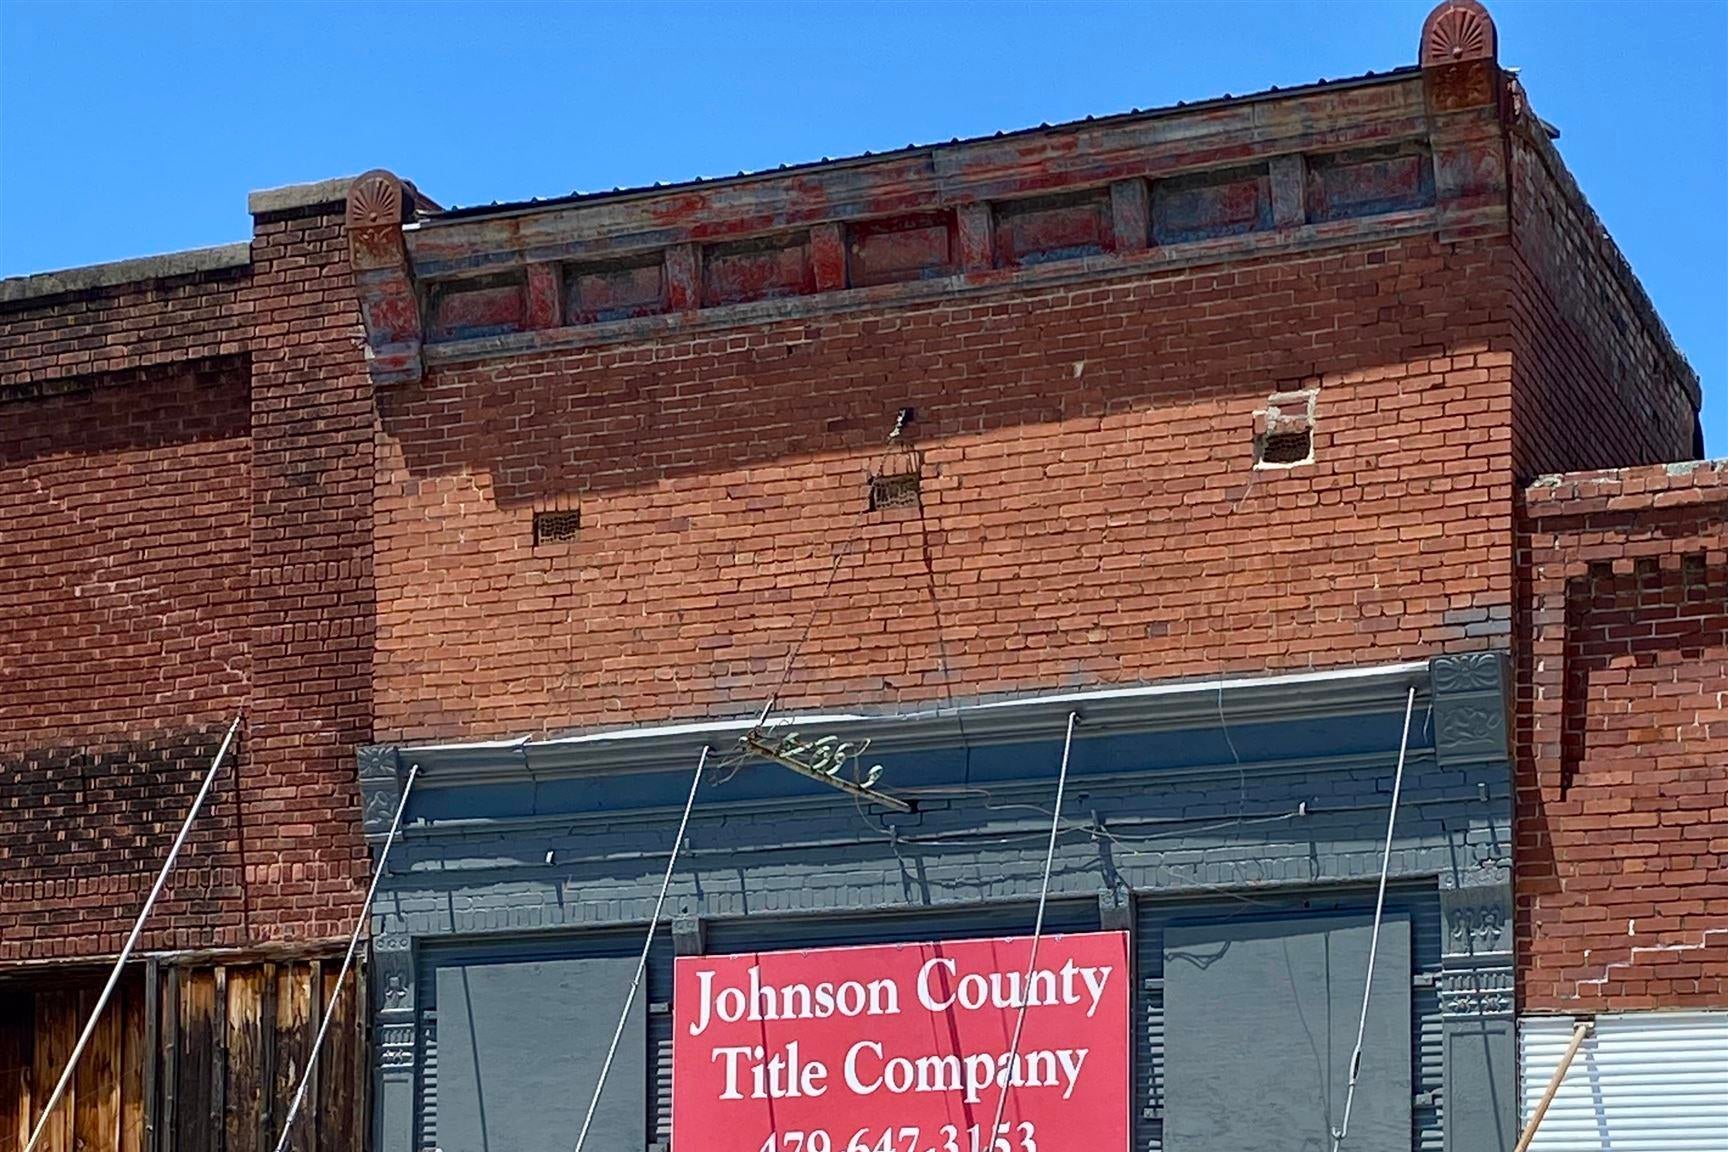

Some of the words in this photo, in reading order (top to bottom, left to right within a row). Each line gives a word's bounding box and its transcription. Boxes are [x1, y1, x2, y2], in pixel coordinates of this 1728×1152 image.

[689, 965, 900, 1036] Johnson
[917, 957, 1113, 1018] County
[712, 1040, 828, 1101] Title
[843, 1039, 1089, 1104] Company
